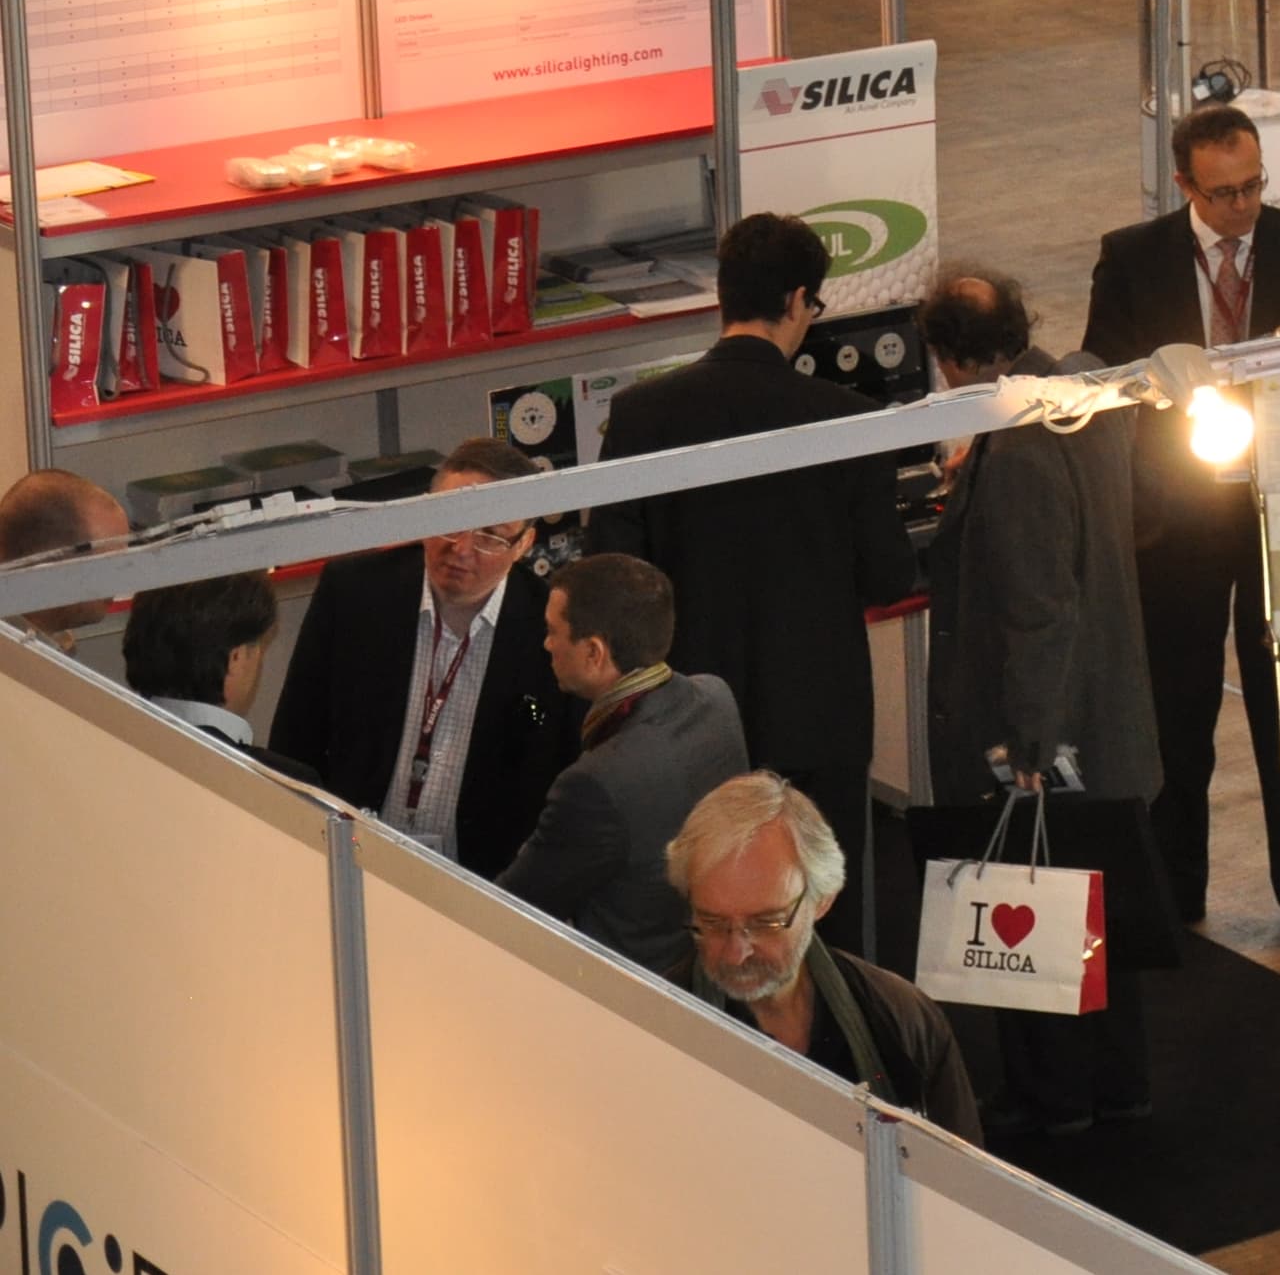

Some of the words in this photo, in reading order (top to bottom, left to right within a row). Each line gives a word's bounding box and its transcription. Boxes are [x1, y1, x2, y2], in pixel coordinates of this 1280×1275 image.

[493, 46, 663, 82] www.silicalighting.com
[801, 67, 916, 111] SILICA
[68, 313, 83, 365] SILICA
[967, 902, 988, 946] I
[963, 950, 1036, 974] SILICA
